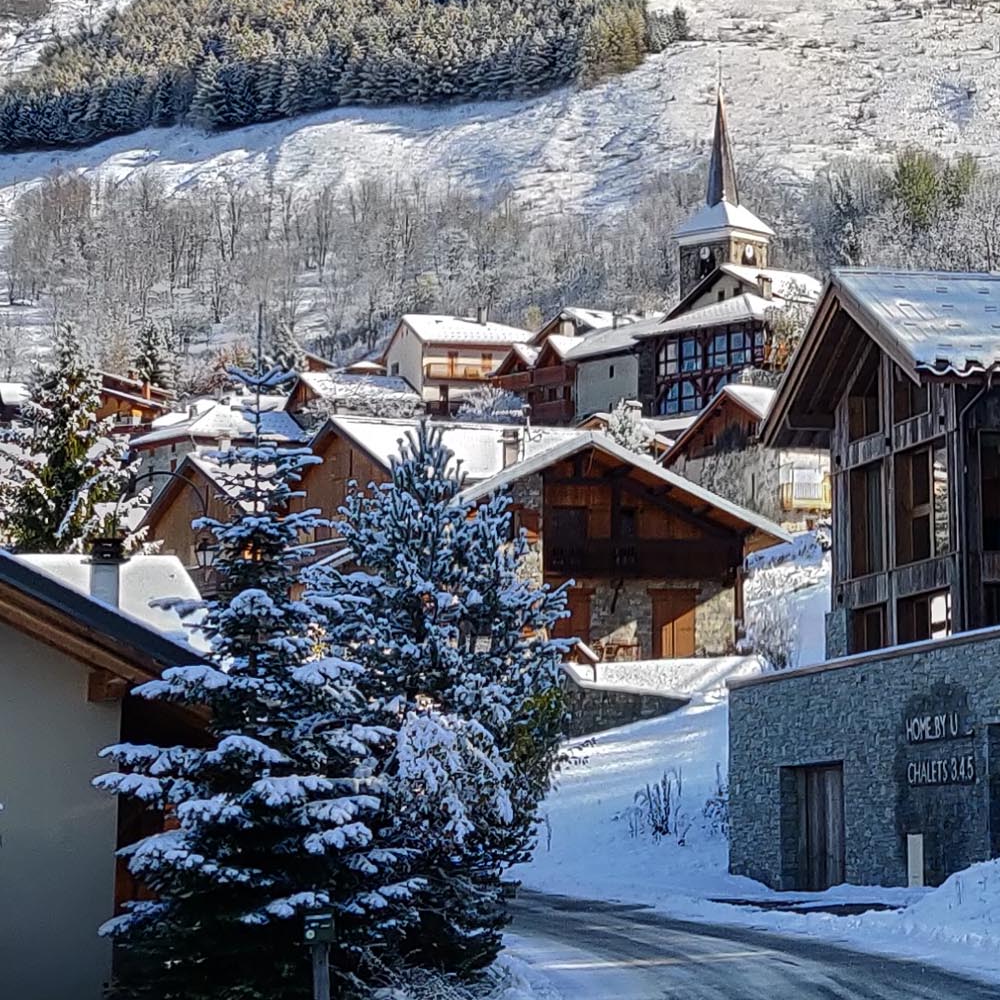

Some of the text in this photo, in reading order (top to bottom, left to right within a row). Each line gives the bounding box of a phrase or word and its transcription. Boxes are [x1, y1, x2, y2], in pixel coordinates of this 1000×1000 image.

[905, 712, 958, 741] HOME BY U
[907, 759, 948, 784] CHALETS
